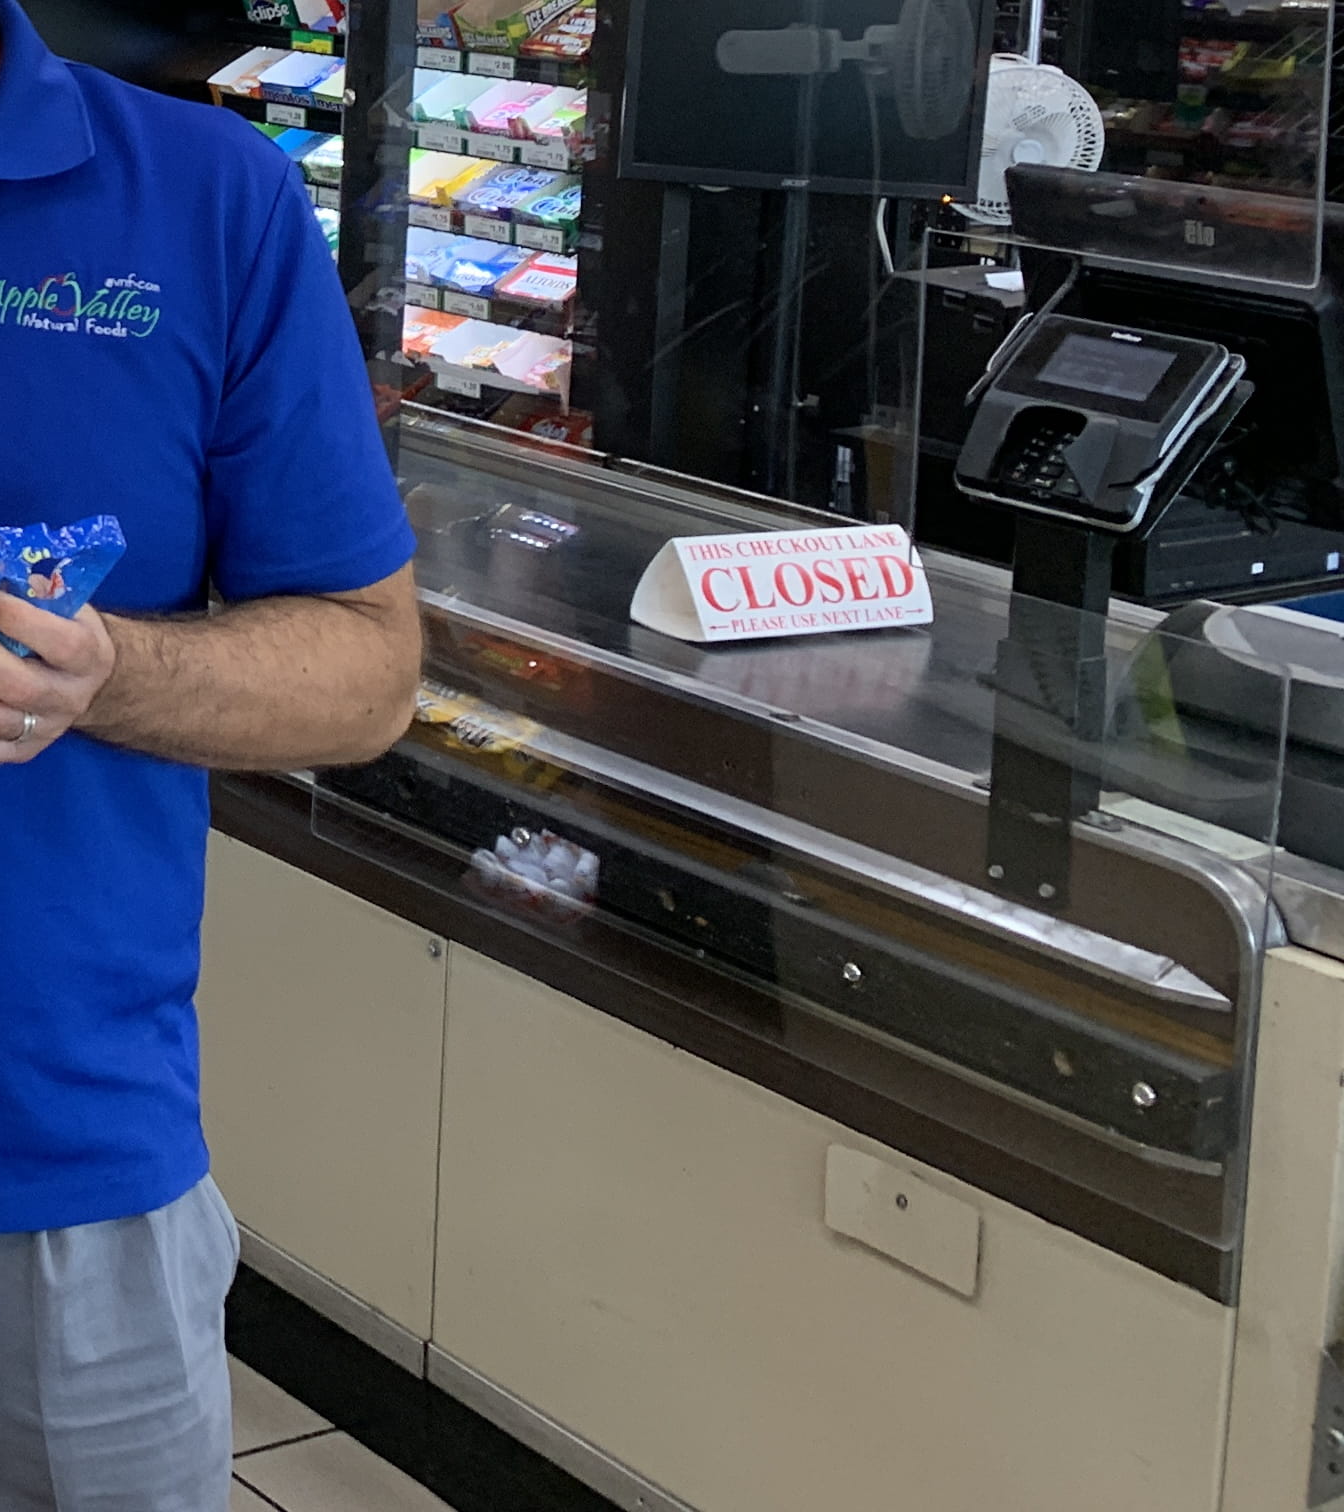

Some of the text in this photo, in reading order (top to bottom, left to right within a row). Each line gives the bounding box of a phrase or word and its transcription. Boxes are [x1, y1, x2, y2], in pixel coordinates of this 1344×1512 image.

[526, 11, 543, 32] ICE
[64, 279, 160, 337] Valley
[23, 312, 129, 338] Natural Foods
[685, 531, 903, 562] THIS CHECKOUT LANE
[701, 554, 914, 614] CLOSED
[731, 606, 905, 634] PLEASE USE NEXT LANE
